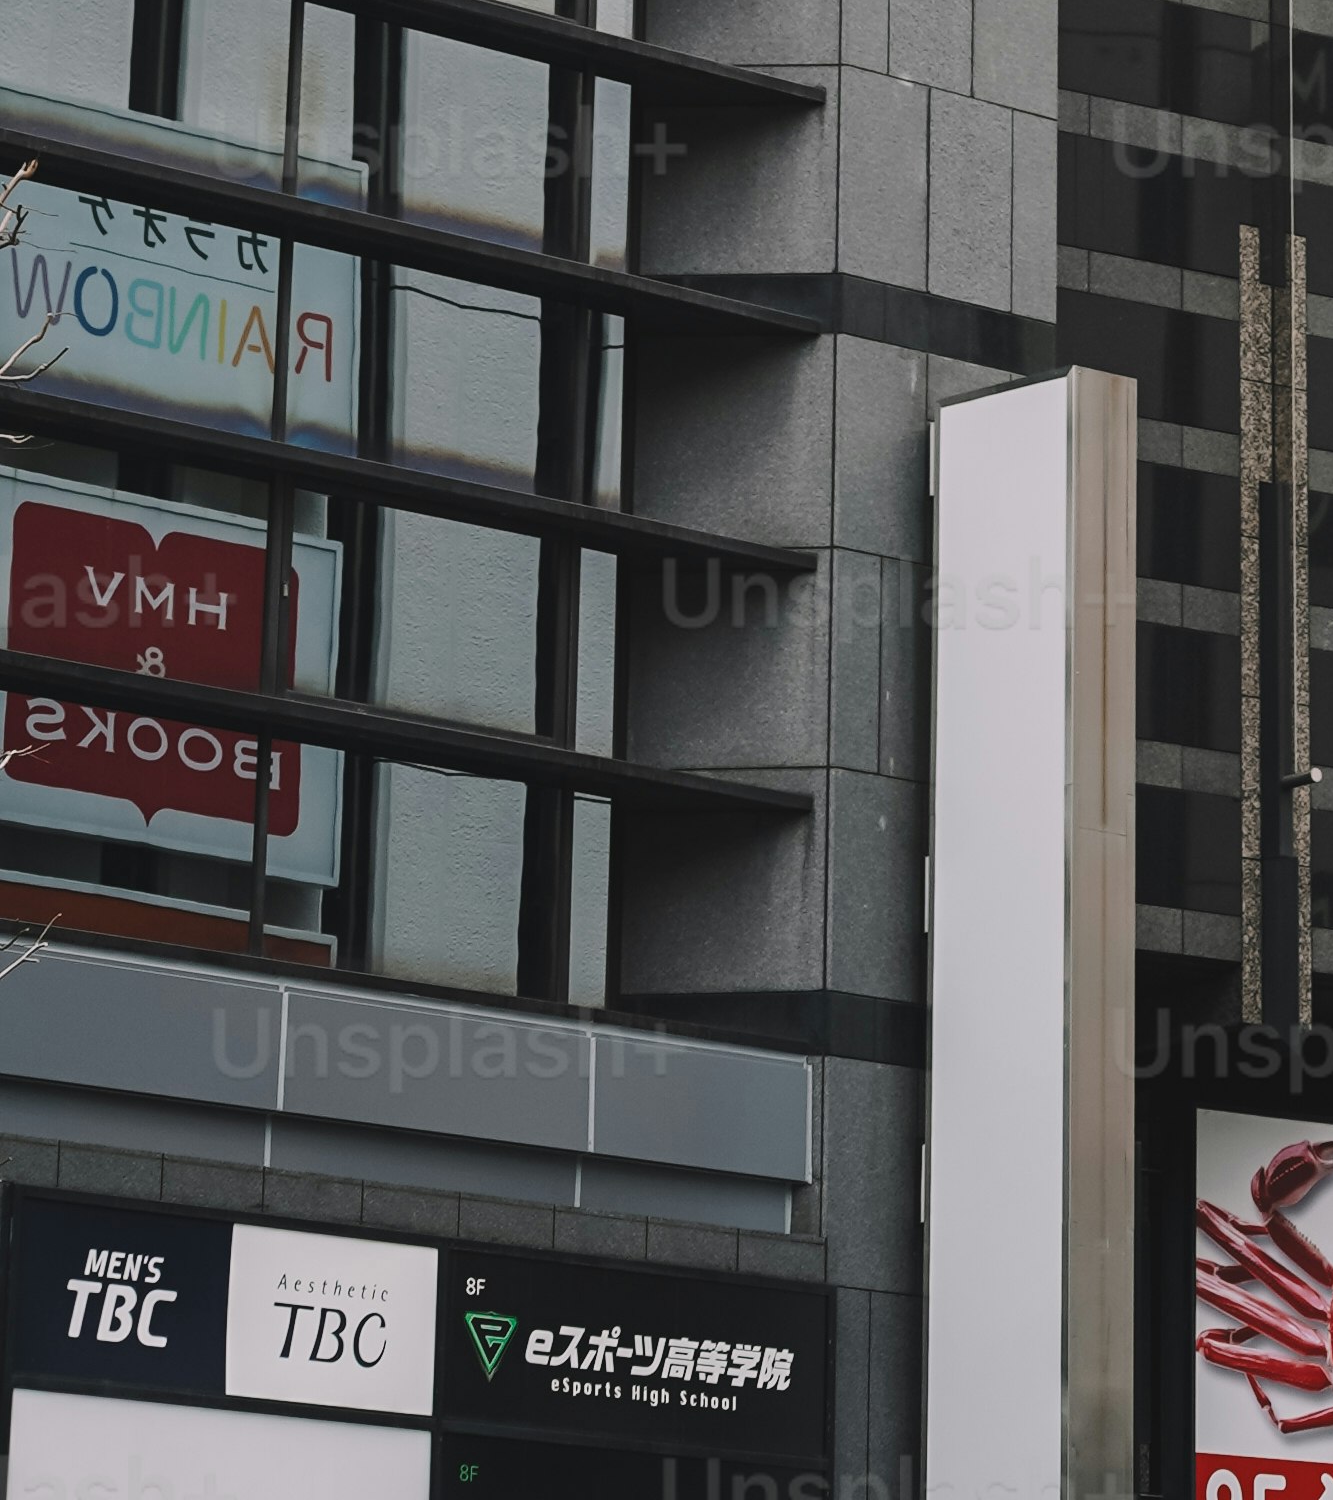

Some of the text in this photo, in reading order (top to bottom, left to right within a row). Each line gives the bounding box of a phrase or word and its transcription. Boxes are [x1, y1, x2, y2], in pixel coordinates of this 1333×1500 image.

[83, 1248, 165, 1284] MEN'S
[277, 1273, 390, 1303] Aesthetic
[465, 1276, 487, 1296] 8F
[66, 1278, 178, 1348] TBC
[273, 1301, 389, 1368] TBC
[524, 1325, 795, 1392] eスポーツ高等学院
[550, 1376, 738, 1413] eSports High School
[459, 1463, 480, 1483] 8F
